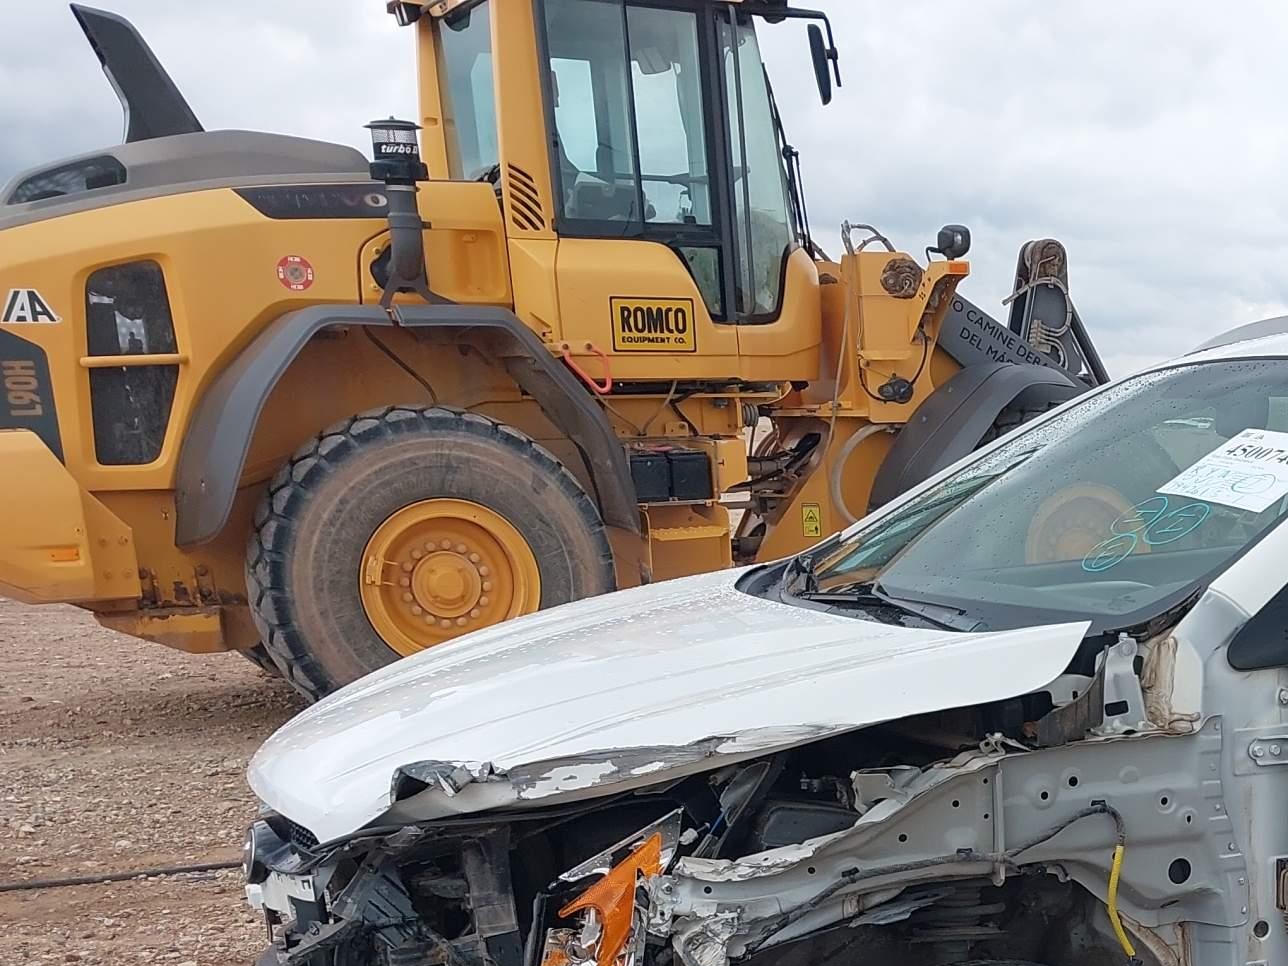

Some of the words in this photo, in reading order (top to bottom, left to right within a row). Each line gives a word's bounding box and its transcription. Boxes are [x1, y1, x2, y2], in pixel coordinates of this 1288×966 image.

[620, 306, 687, 334] ROMCO
[966, 309, 1016, 350] CAMINE
[622, 336, 670, 344] EQUIPMENT
[960, 327, 982, 351] DEL
[1, 360, 43, 416] L90H
